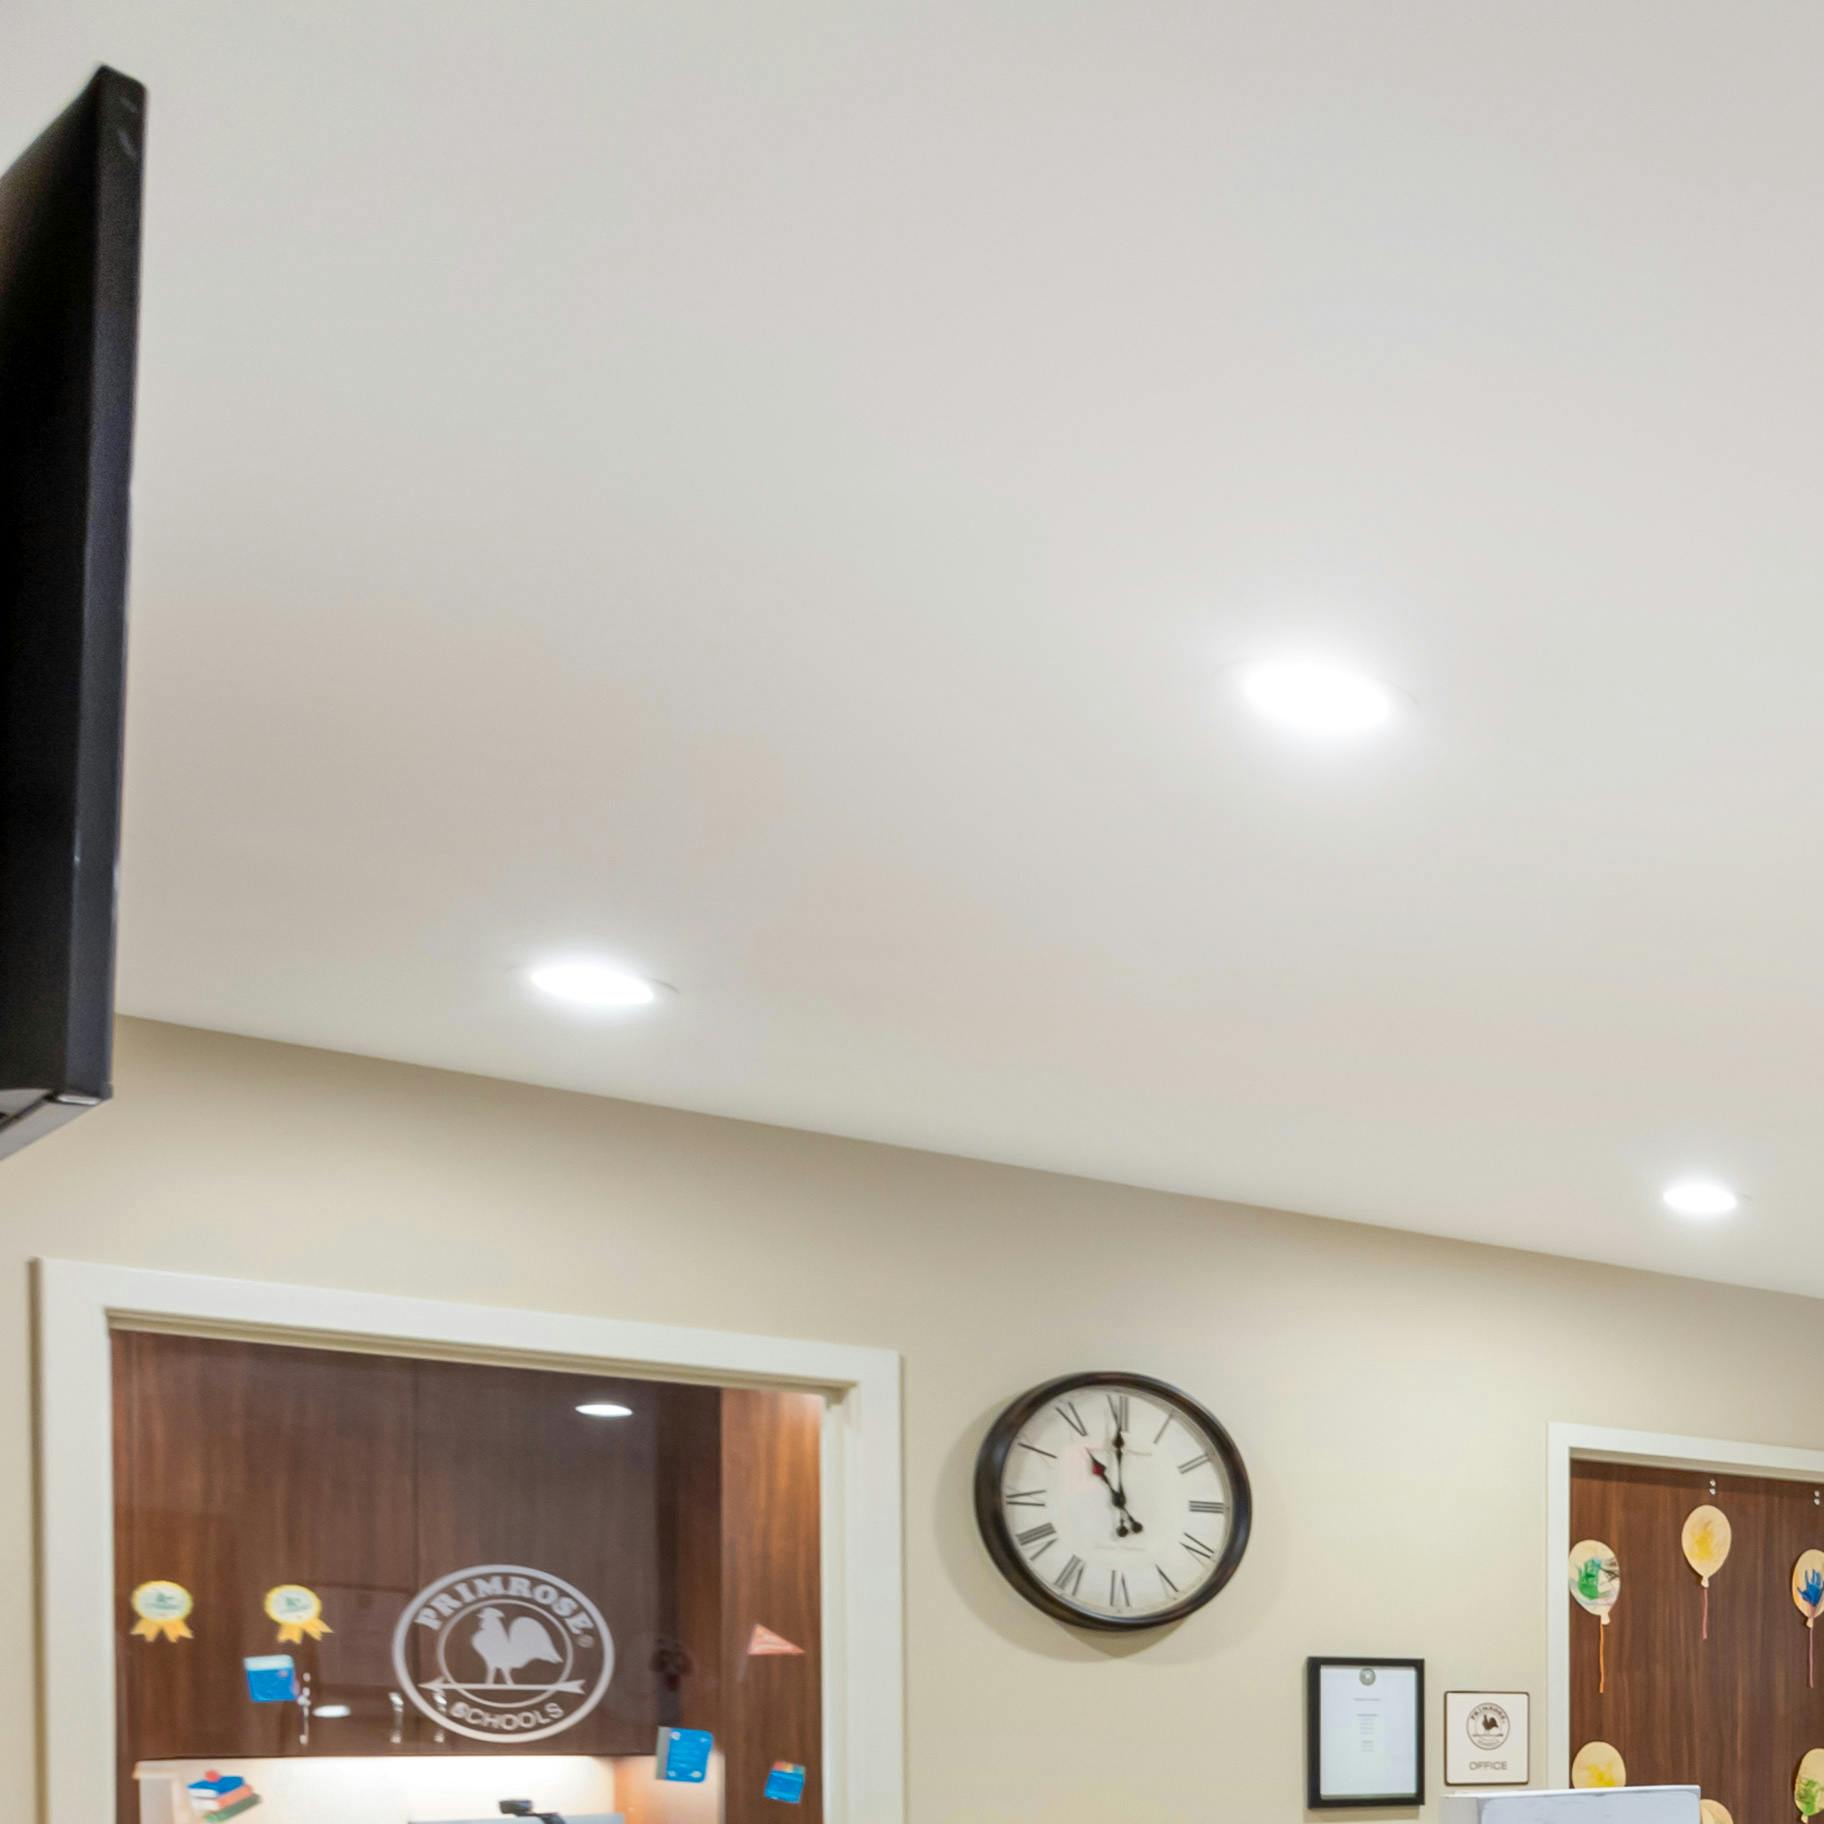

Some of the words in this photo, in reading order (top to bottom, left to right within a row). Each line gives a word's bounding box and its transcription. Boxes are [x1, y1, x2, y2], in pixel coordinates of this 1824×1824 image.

[414, 1576, 595, 1634] PRIMROSE
[450, 1702, 565, 1731] SCHOOLS
[1468, 1761, 1508, 1771] OFFICE
